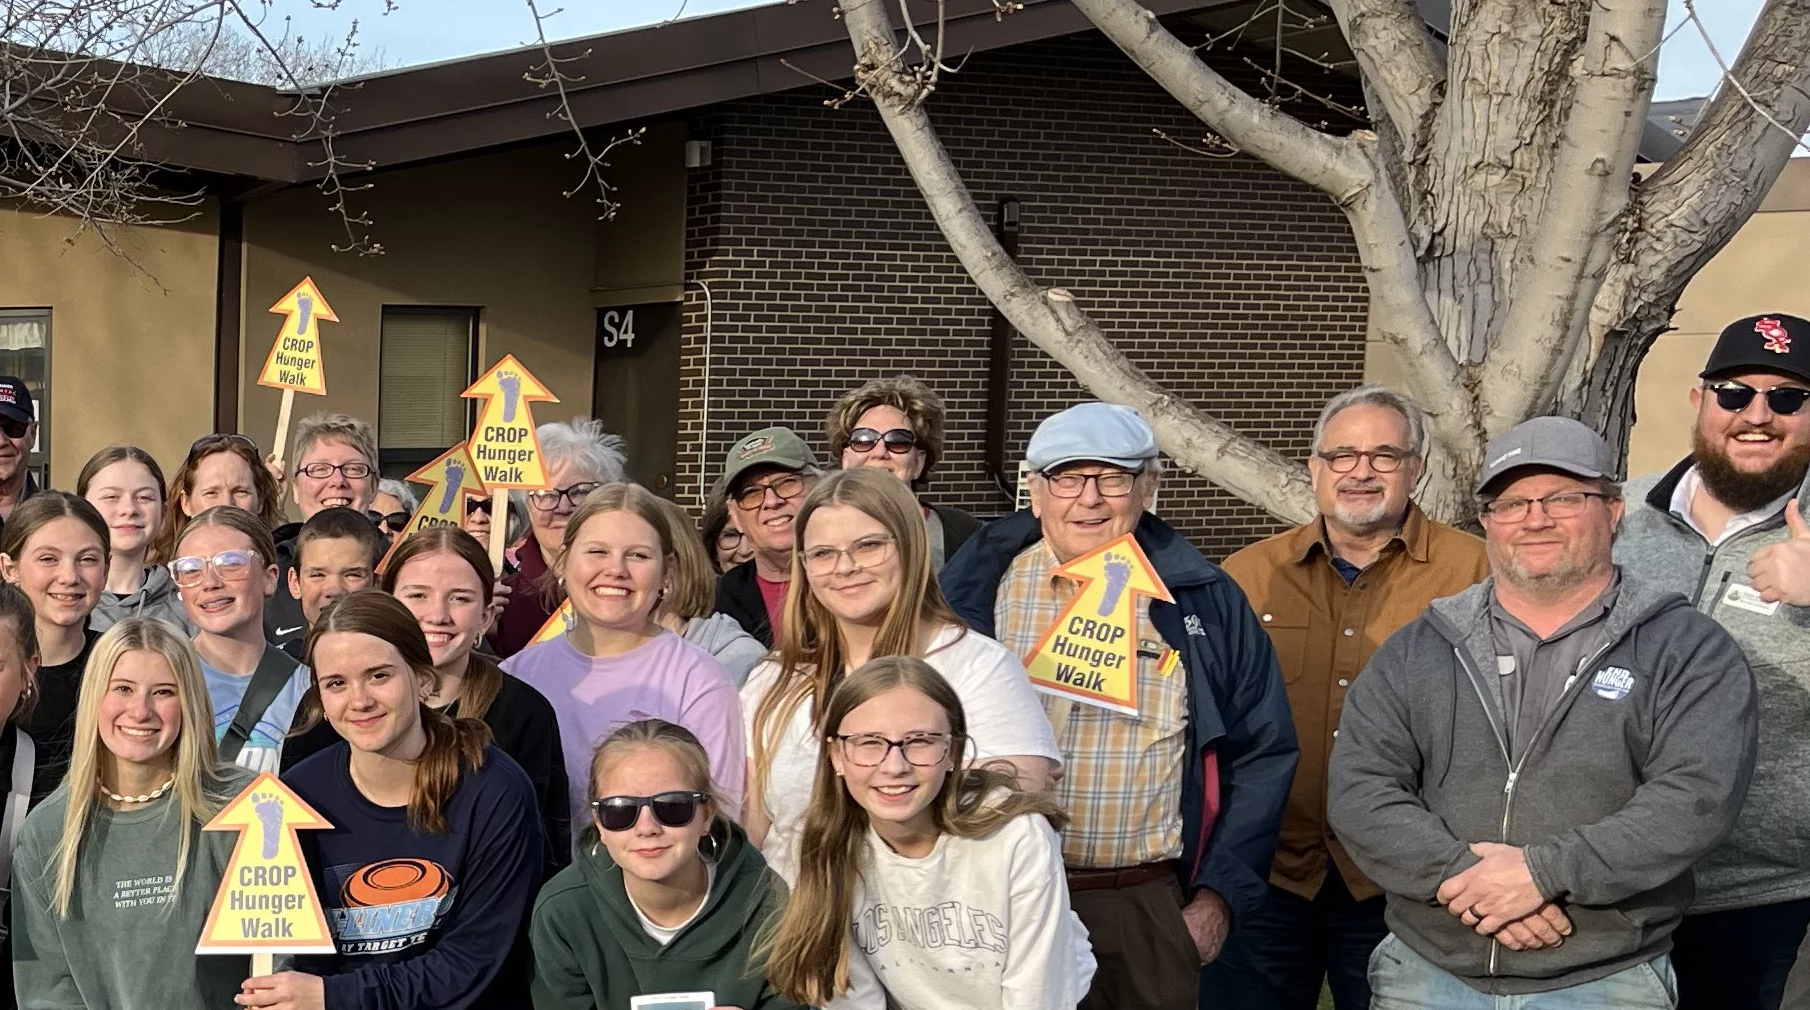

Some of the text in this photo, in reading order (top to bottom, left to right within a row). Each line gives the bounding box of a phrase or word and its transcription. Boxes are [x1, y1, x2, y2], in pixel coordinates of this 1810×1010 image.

[603, 309, 635, 348] S4
[282, 336, 314, 353] CROP
[275, 351, 316, 370] Hunger
[279, 370, 307, 387] Walk
[484, 426, 528, 443] CROP
[476, 444, 534, 465] Hunger
[483, 466, 523, 483] Walk
[1067, 616, 1125, 644] CROP
[1051, 635, 1126, 669] Hunger
[1055, 662, 1106, 692] Walk
[1594, 670, 1635, 690] HUNGER
[1606, 666, 1631, 678] END
[116, 876, 173, 889] THE WORLD IS
[240, 865, 297, 887] CROP
[115, 899, 138, 909] WITH
[139, 897, 155, 906] YOU
[155, 896, 166, 904] IN
[121, 888, 152, 898] BETTER
[230, 890, 306, 914] Hunger
[241, 917, 294, 938] Walk
[891, 900, 1011, 954] ANGELES
[358, 935, 408, 951] TARGET
[410, 931, 428, 944] TE
[880, 957, 1002, 974] ALIFORNIA
